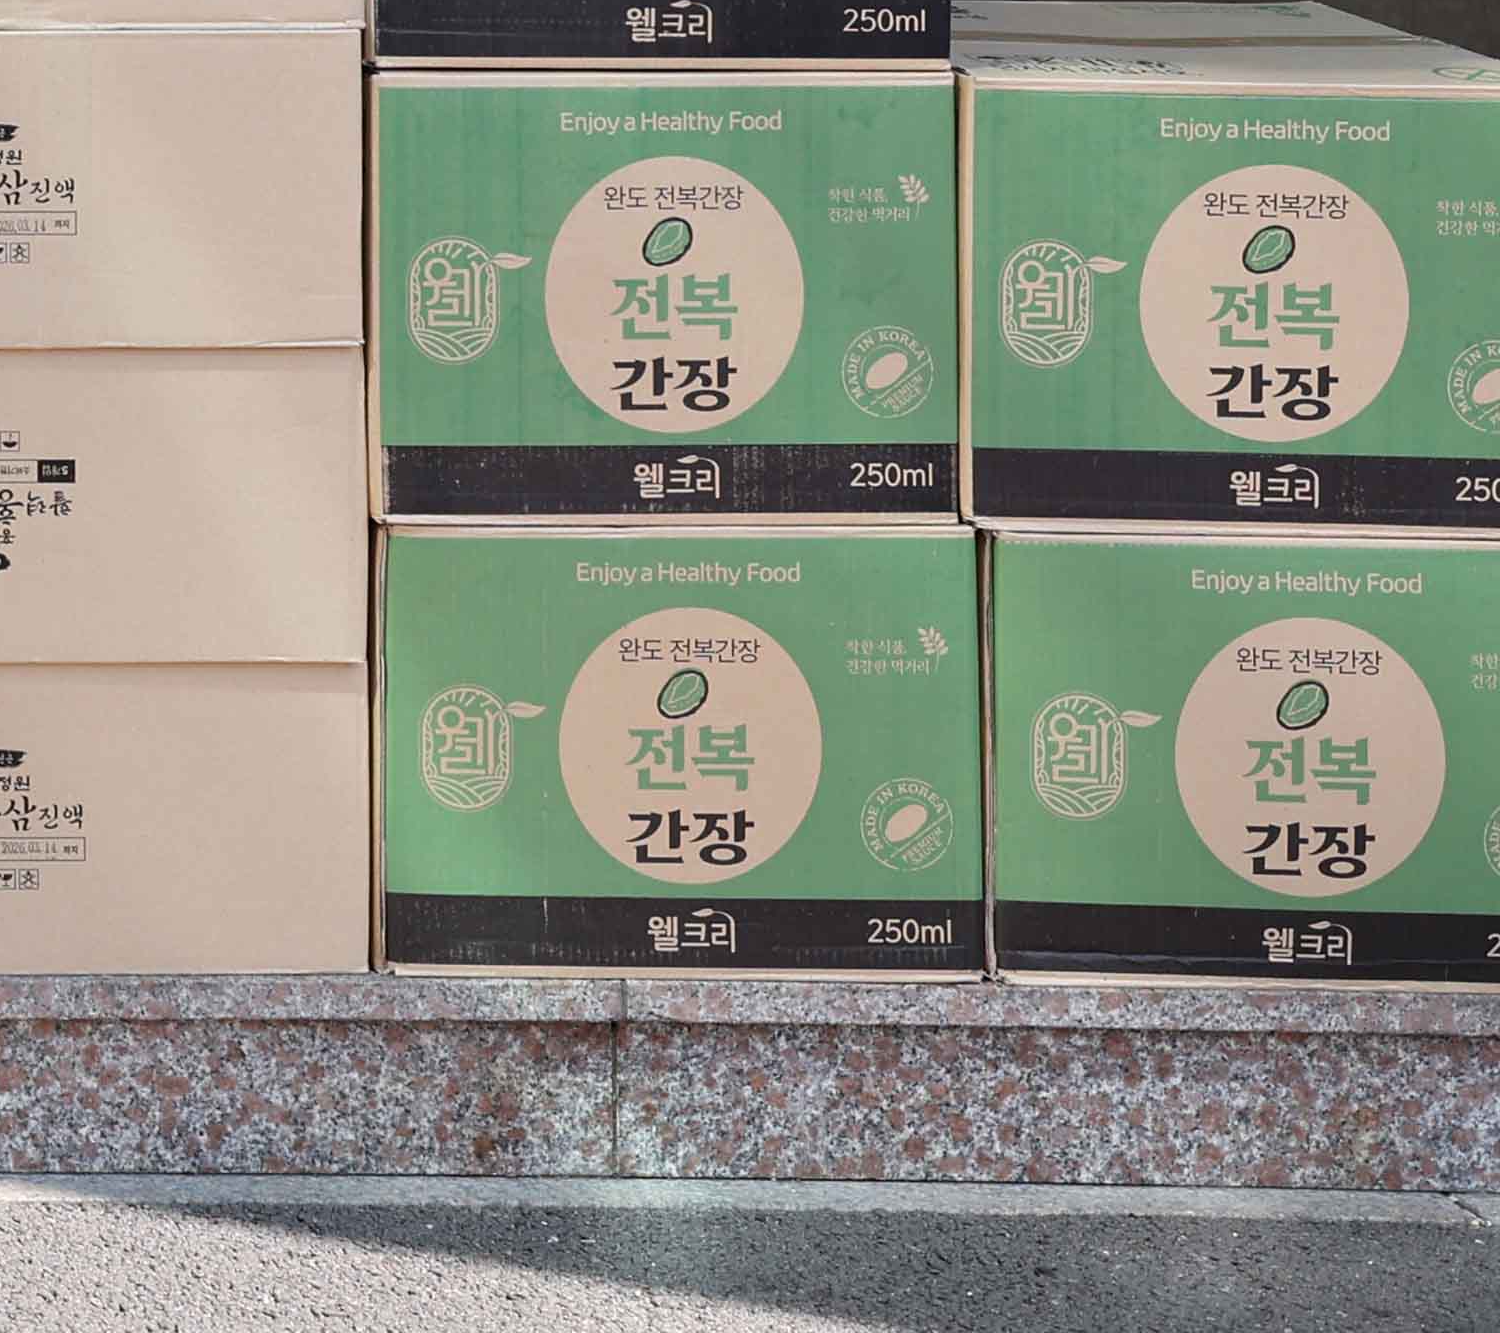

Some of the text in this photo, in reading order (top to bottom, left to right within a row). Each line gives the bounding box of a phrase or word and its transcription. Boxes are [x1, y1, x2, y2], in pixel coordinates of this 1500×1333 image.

[841, 9, 925, 34] 250ml
[559, 109, 782, 135] Enjoy a Healthy Food
[603, 186, 742, 212] 완도 전복간장
[610, 273, 739, 339] 전복
[1207, 281, 1341, 348] 전복
[610, 357, 739, 413] 간장
[847, 329, 928, 399] MADE IN KOREA
[1205, 365, 1339, 423] 간장
[847, 463, 931, 488] 250ml
[625, 724, 756, 791] 전복
[1242, 736, 1376, 804] 전복
[625, 809, 756, 866] 간장
[1241, 821, 1375, 879] 간장
[866, 919, 952, 944] 250ml
